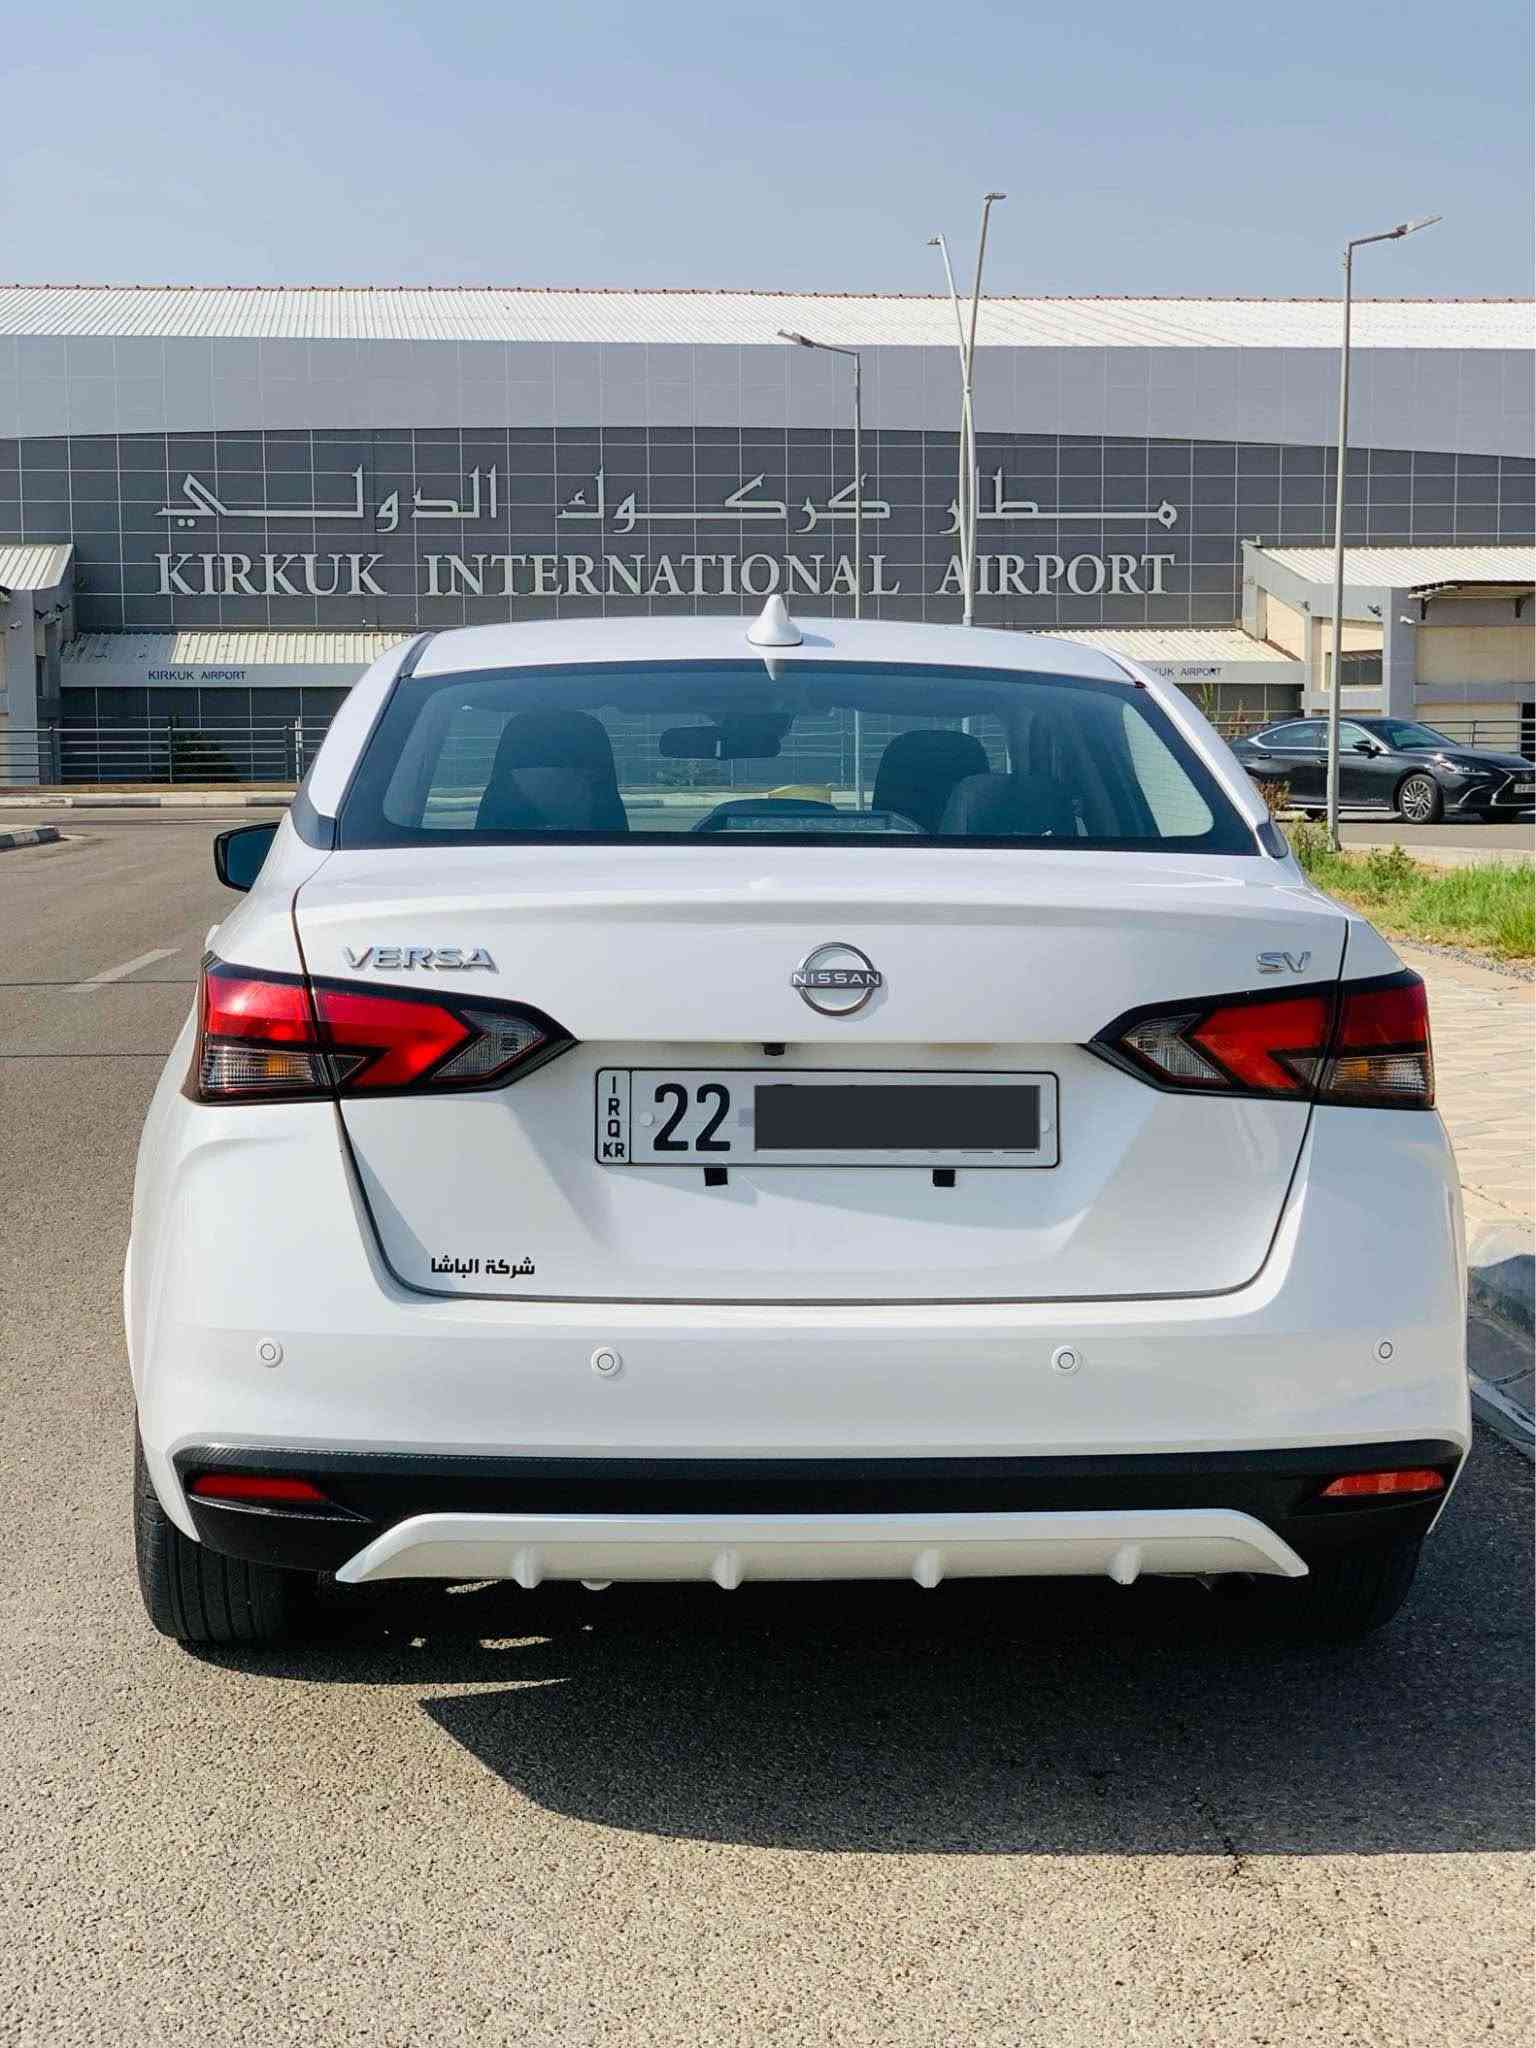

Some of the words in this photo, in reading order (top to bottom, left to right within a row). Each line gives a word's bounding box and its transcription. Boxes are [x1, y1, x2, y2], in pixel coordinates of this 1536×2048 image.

[154, 464, 497, 533] الدولي
[552, 466, 891, 534] كركوك
[155, 552, 388, 596] KIRKUK
[423, 553, 901, 597] INTERNATIONAL
[935, 553, 1176, 596] AIRPORT
[148, 670, 194, 681] KIRKUK
[201, 670, 246, 681] AIRPORT
[1181, 666, 1222, 677] AIRPORT
[344, 946, 499, 974] VERSA
[1256, 951, 1312, 975] SV
[793, 972, 880, 986] NISSAN
[653, 1083, 731, 1151] 22
[602, 1142, 625, 1158] KR
[431, 1254, 480, 1279] الباشا
[485, 1256, 535, 1279] شركة
